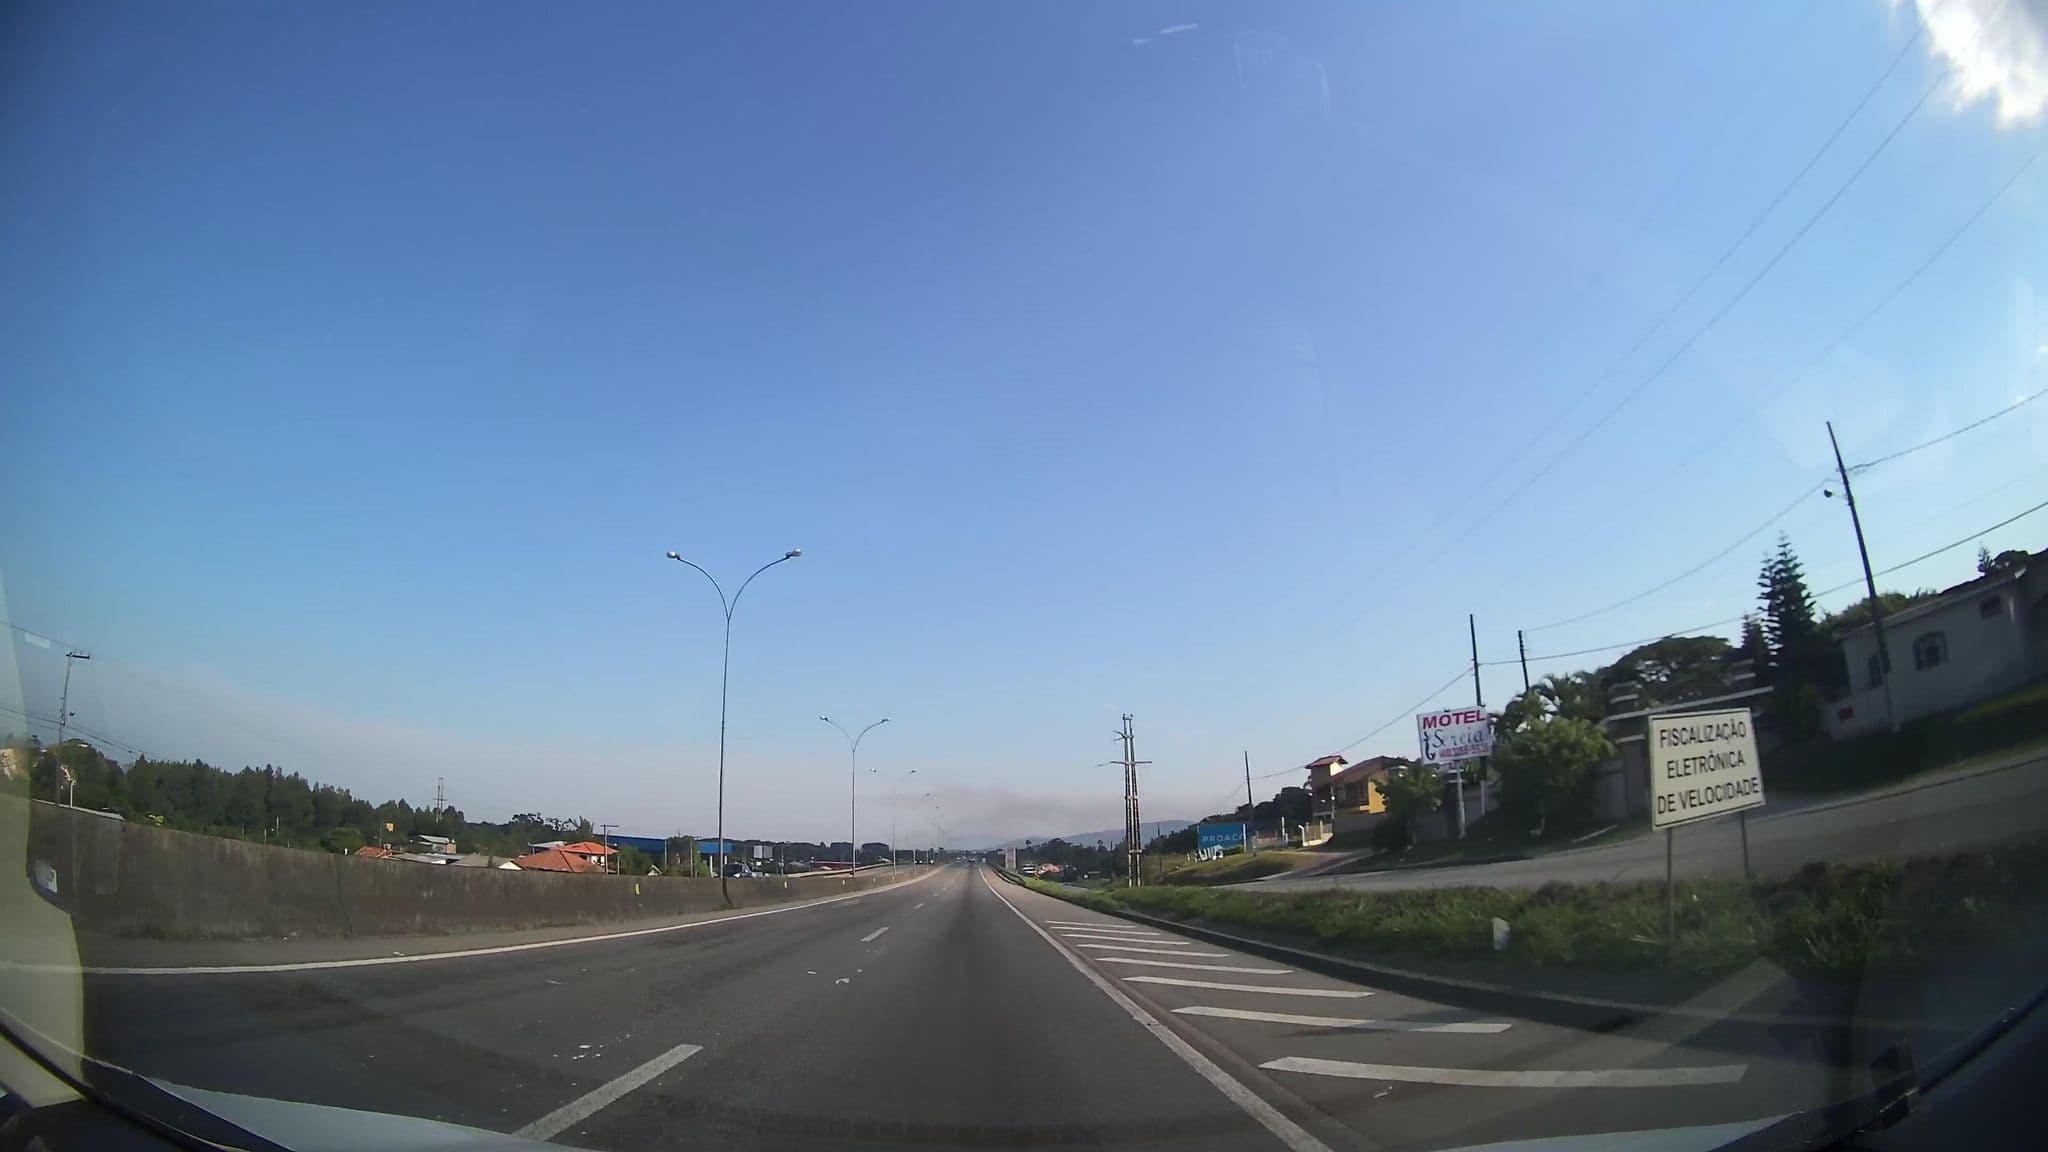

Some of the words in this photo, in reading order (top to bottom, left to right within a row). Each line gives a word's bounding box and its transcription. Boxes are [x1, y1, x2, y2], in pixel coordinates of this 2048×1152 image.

[1423, 710, 1485, 729] MOTEL
[1660, 719, 1746, 748] FISCALIZAÇÃO
[1667, 750, 1745, 779] ELETRÔNICA
[1657, 793, 1677, 815] DE
[1679, 777, 1760, 810] VELOCIDADE
